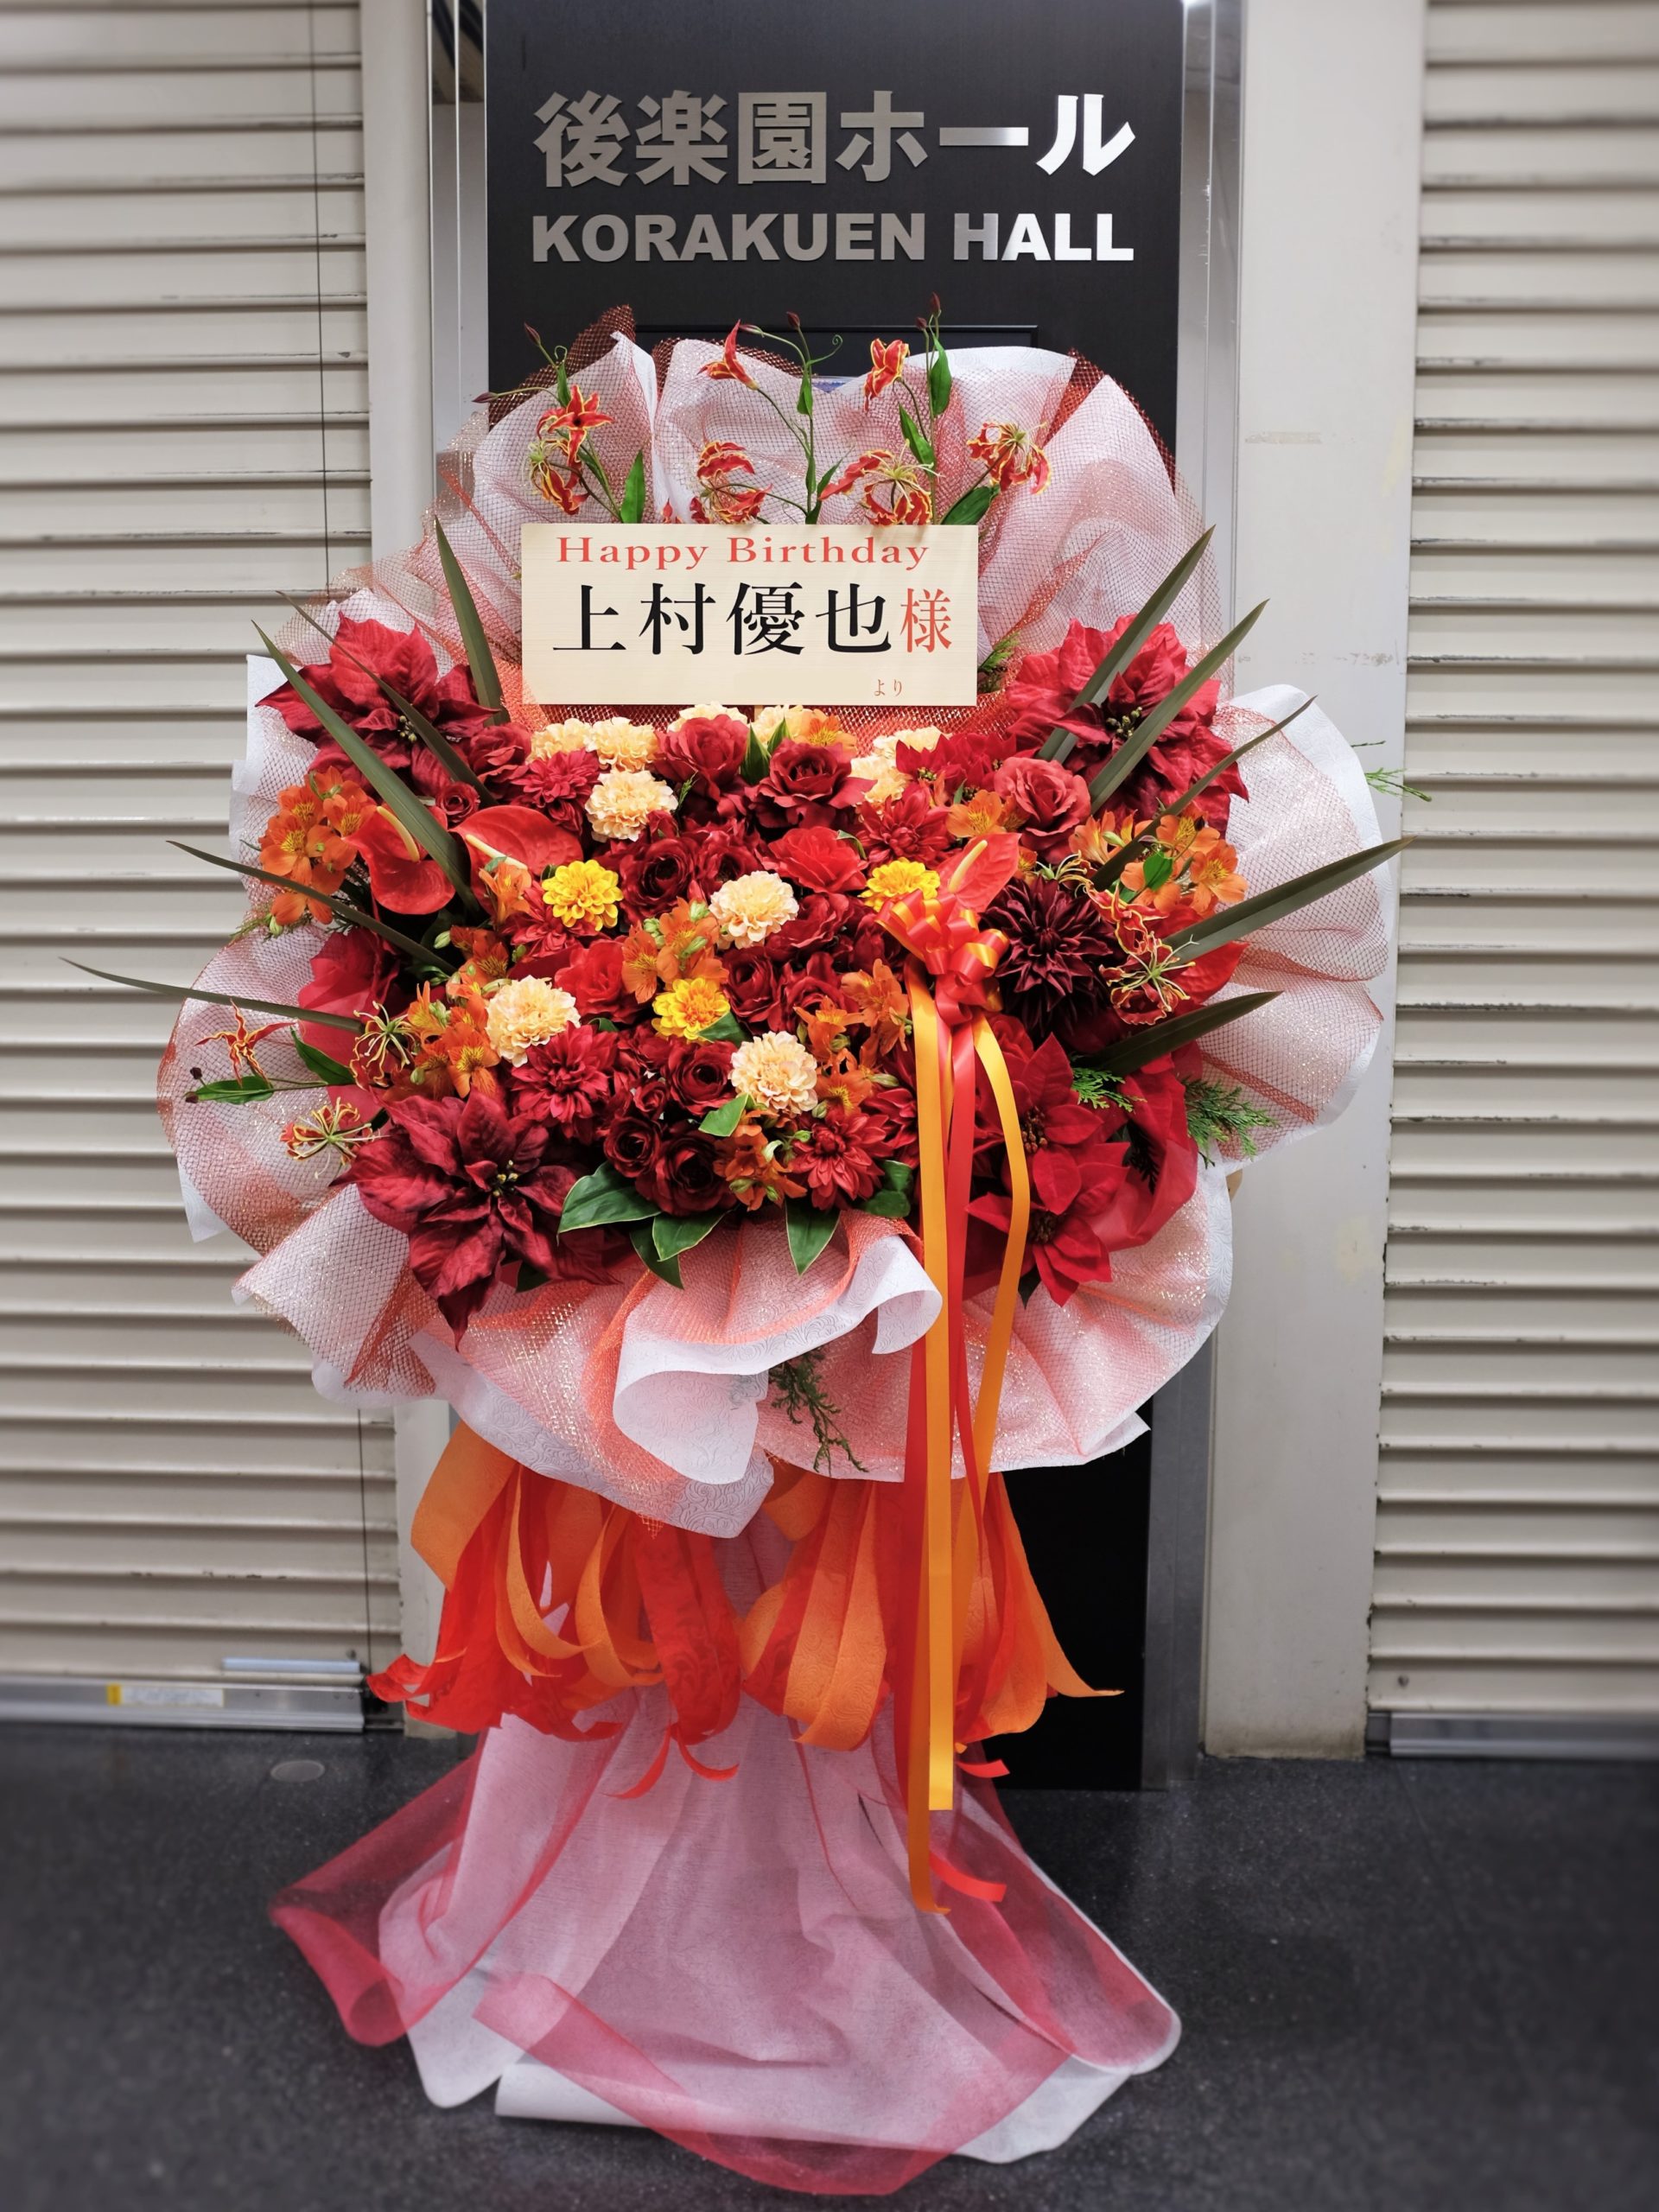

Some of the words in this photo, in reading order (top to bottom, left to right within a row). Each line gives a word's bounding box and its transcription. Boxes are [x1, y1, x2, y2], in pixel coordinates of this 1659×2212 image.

[533, 90, 1135, 188] 後楽園ホール
[532, 213, 925, 262] KORAKUEN
[953, 213, 1135, 262] HALL
[556, 537, 709, 570] Happy
[727, 536, 929, 570] Birthday
[553, 582, 952, 656] 上村優也様
[874, 678, 904, 697] より
